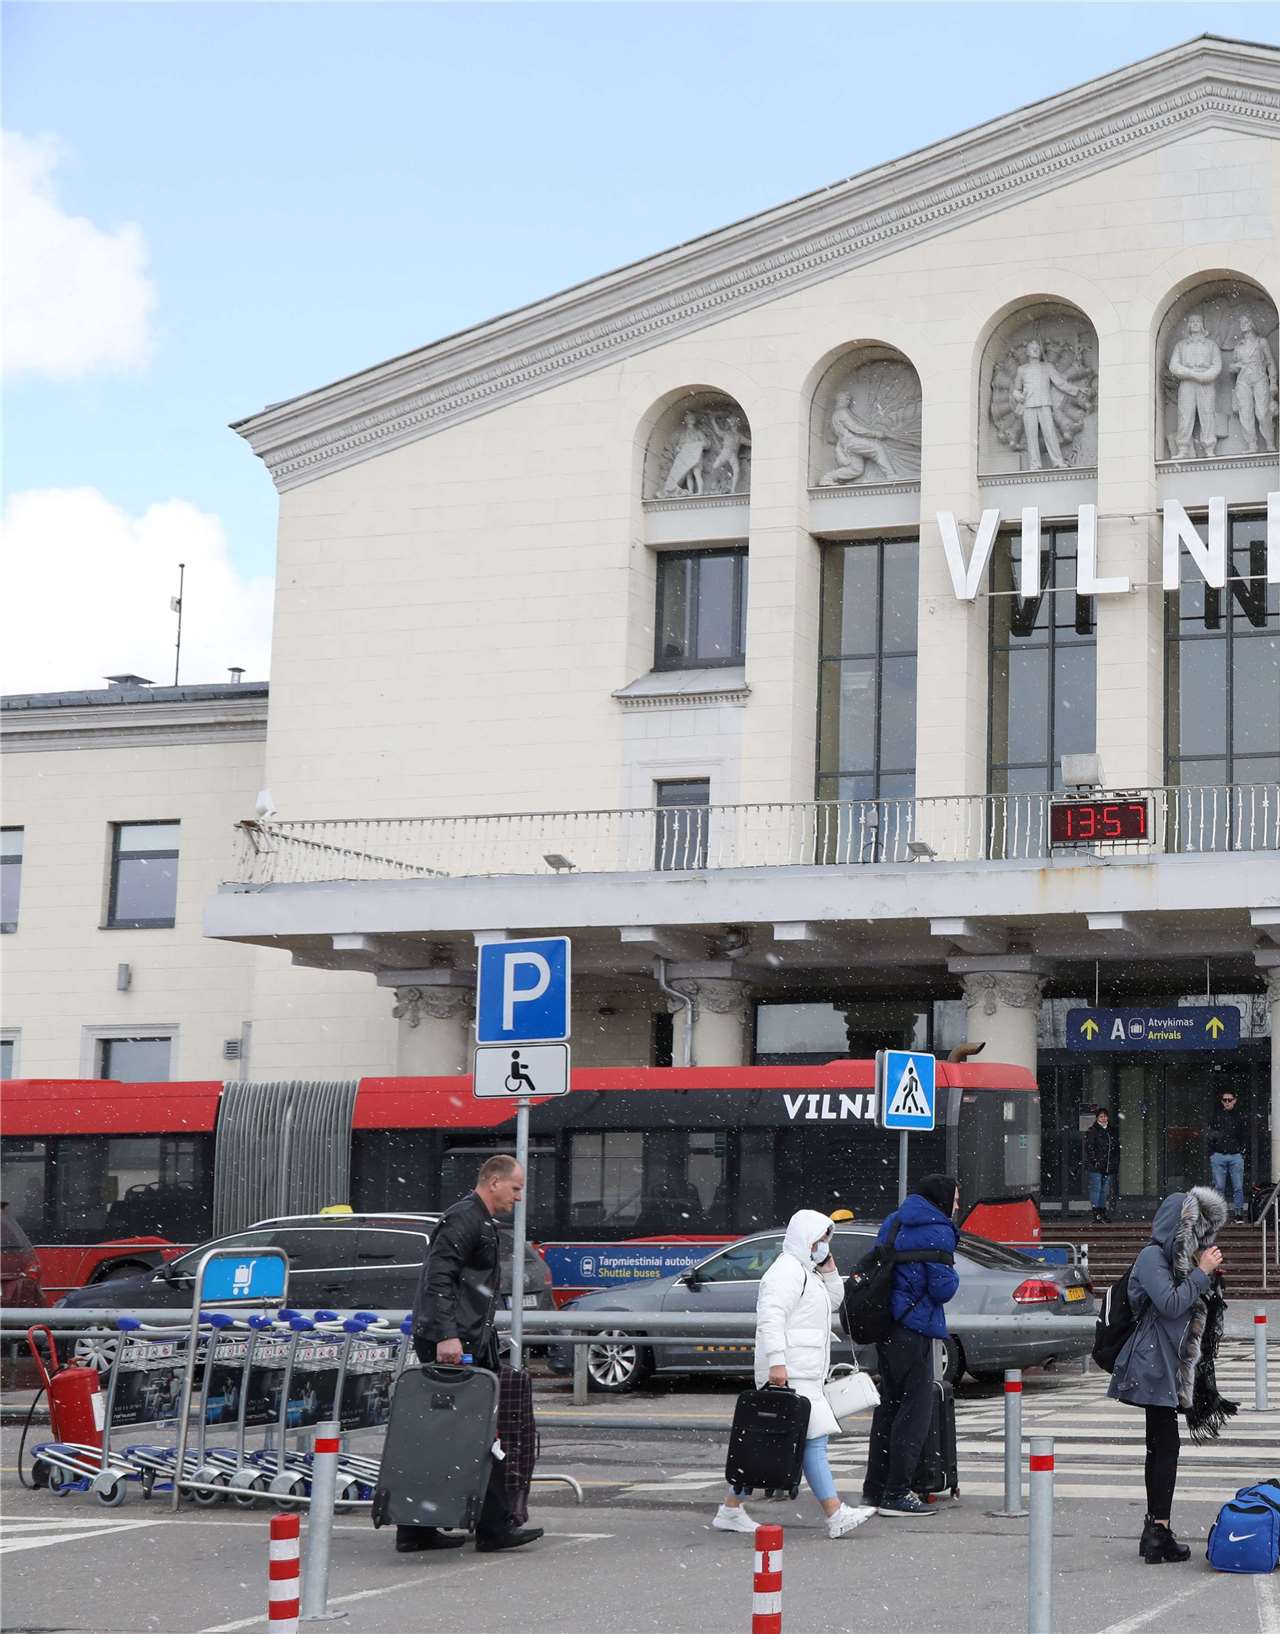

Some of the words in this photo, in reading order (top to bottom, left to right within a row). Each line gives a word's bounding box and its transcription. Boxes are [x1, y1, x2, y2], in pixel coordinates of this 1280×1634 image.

[1065, 805, 1145, 838] 13:57
[502, 952, 551, 1031] P
[1110, 1018, 1126, 1040] A
[1148, 1017, 1194, 1029] Atvykimas
[1148, 1030, 1182, 1040] Arrivals
[783, 1093, 877, 1119] VILNI
[598, 1256, 663, 1268] Tarpmiestiniai
[664, 1256, 703, 1266] autobu
[598, 1267, 631, 1278] Shuttle
[633, 1267, 661, 1278] buses
